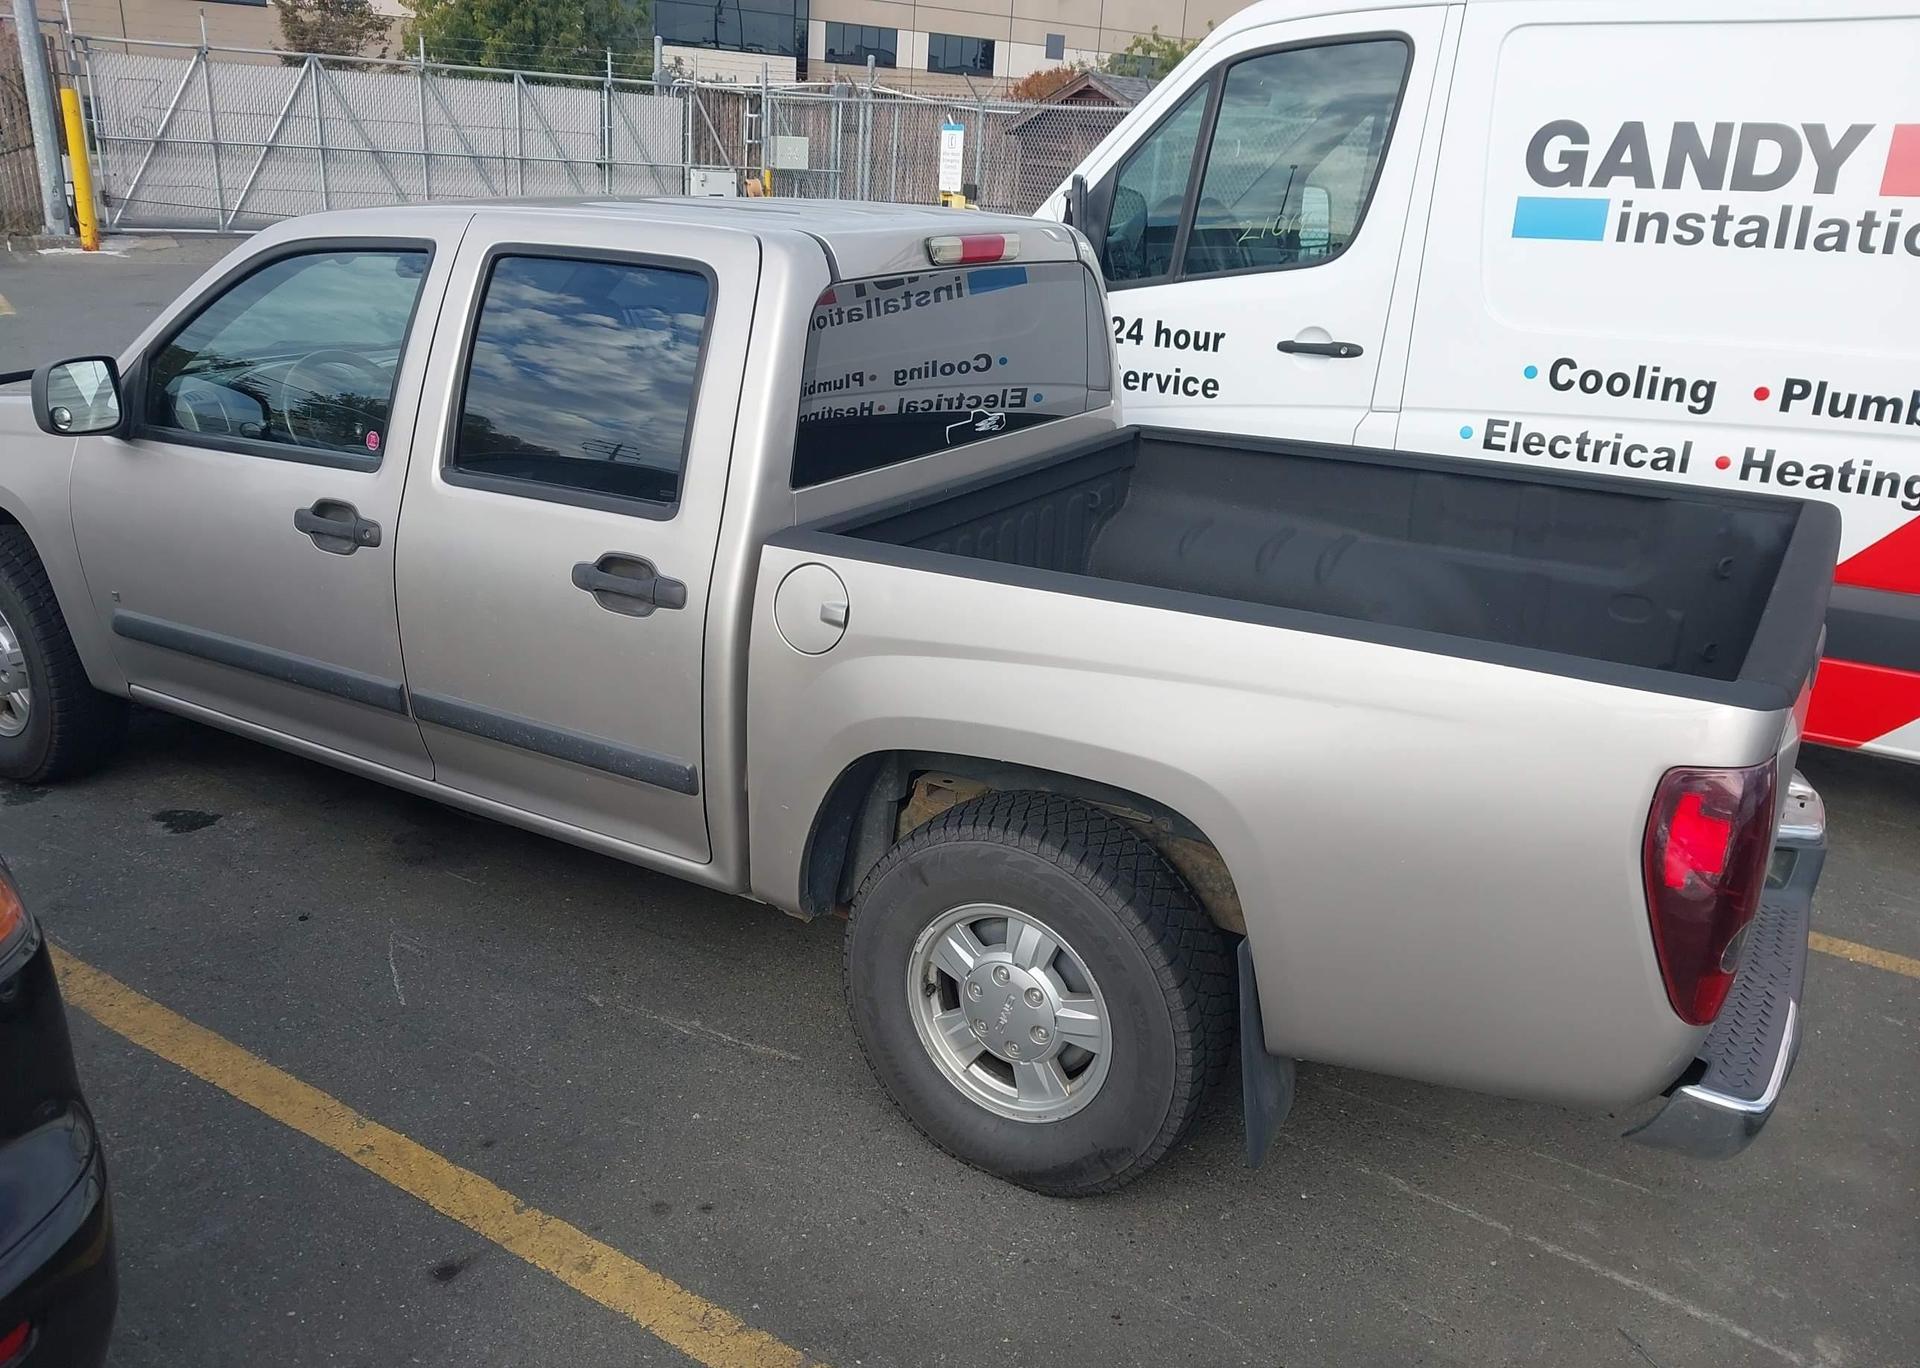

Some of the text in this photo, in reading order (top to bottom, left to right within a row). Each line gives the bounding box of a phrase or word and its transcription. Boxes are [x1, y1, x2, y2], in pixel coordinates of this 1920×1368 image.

[1525, 118, 1877, 195] GANDY
[1111, 315, 1226, 353] 24 hour
[1119, 367, 1220, 399] ervice
[1548, 356, 1717, 415] Cooling
[1482, 418, 1920, 512] Electrical Heating
